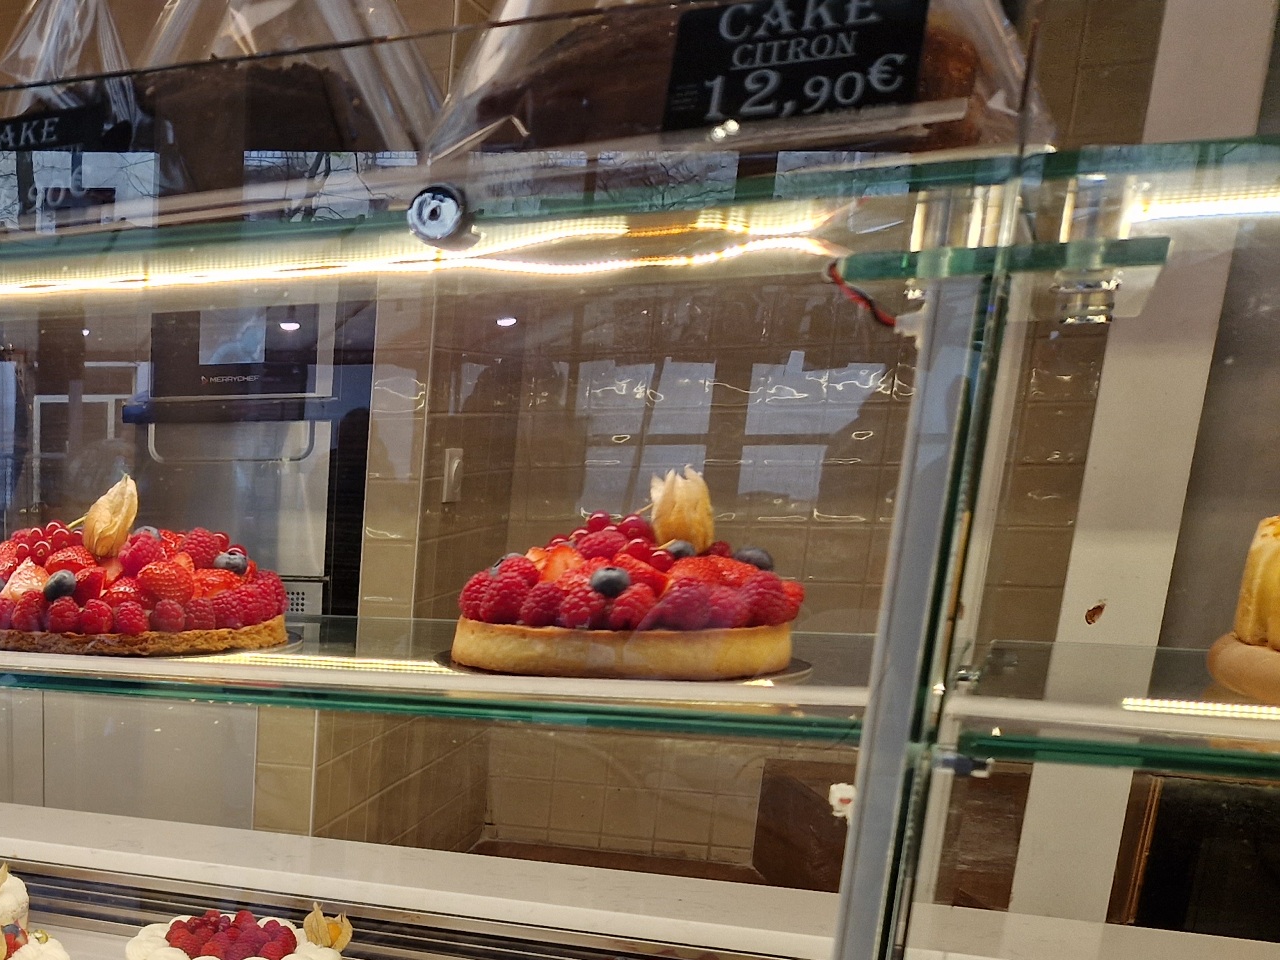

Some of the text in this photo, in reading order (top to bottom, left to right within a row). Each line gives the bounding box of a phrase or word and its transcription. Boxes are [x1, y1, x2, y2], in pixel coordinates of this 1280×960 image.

[720, 0, 882, 41] CAKE
[731, 31, 858, 66] CITRON
[704, 53, 908, 120] 12,90€
